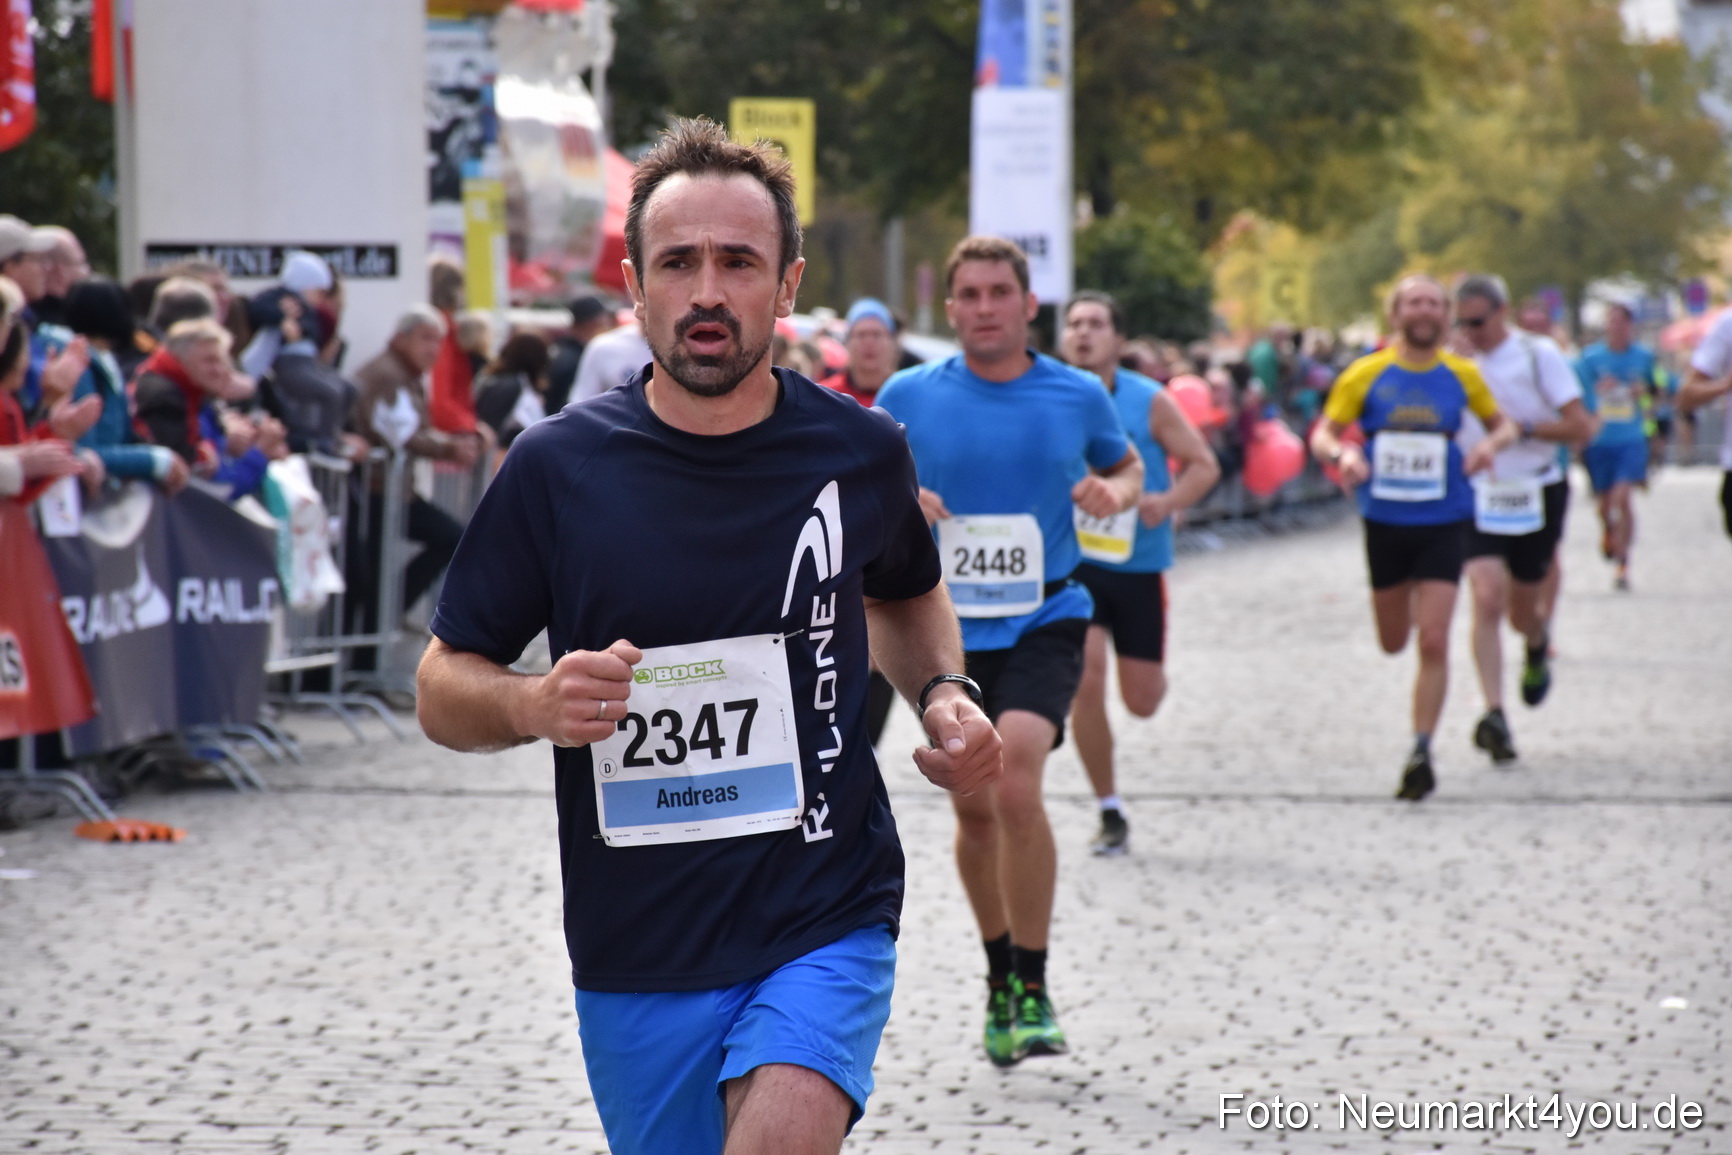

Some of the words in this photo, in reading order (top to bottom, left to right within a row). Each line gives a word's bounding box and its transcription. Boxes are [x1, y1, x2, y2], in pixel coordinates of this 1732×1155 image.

[954, 548, 1026, 576] 2448
[654, 659, 726, 683] BOCK
[656, 681, 677, 689] inspired
[685, 678, 702, 686] smart
[702, 675, 727, 684] concepts
[616, 698, 759, 768] 2347
[604, 762, 612, 774] D
[656, 785, 739, 809] Andreas
